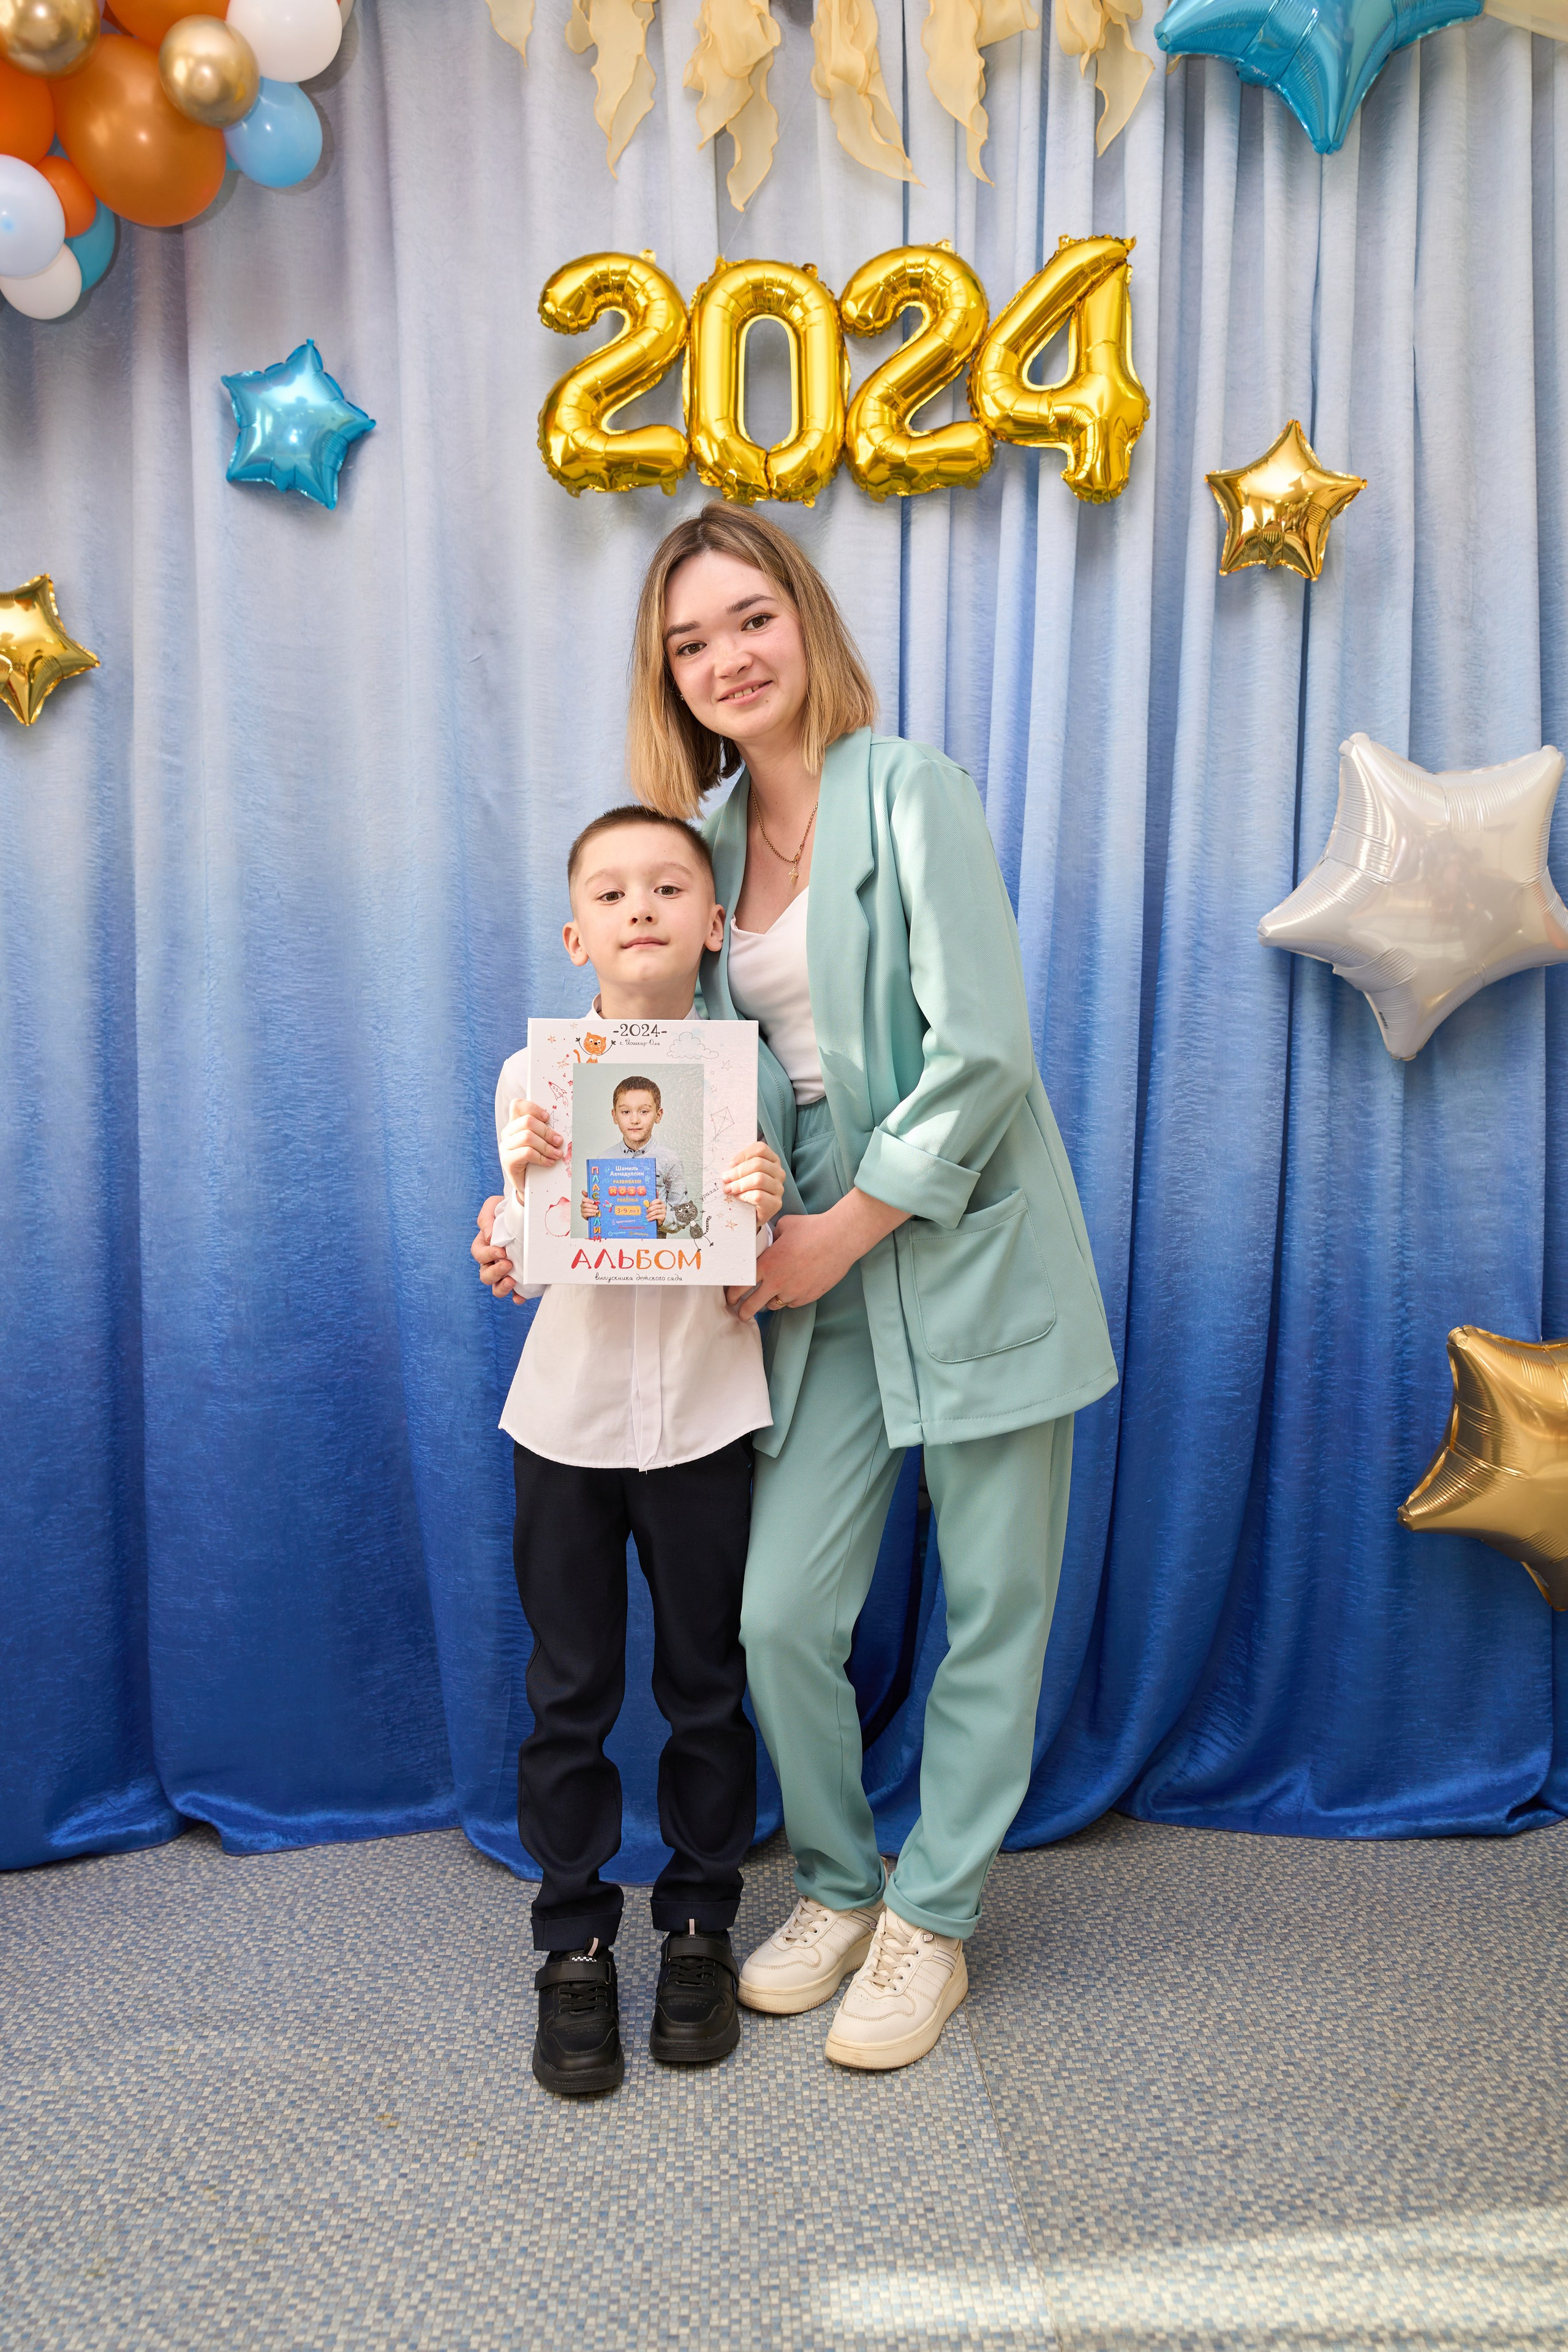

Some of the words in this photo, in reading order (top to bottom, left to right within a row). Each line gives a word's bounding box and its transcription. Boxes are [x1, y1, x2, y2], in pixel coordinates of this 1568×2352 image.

[537, 234, 1150, 506] 2024
[625, 1038, 661, 1047] Йошкар-Ола
[571, 1248, 701, 1270] АЛЬБОМ
[594, 1272, 633, 1283] выпускника
